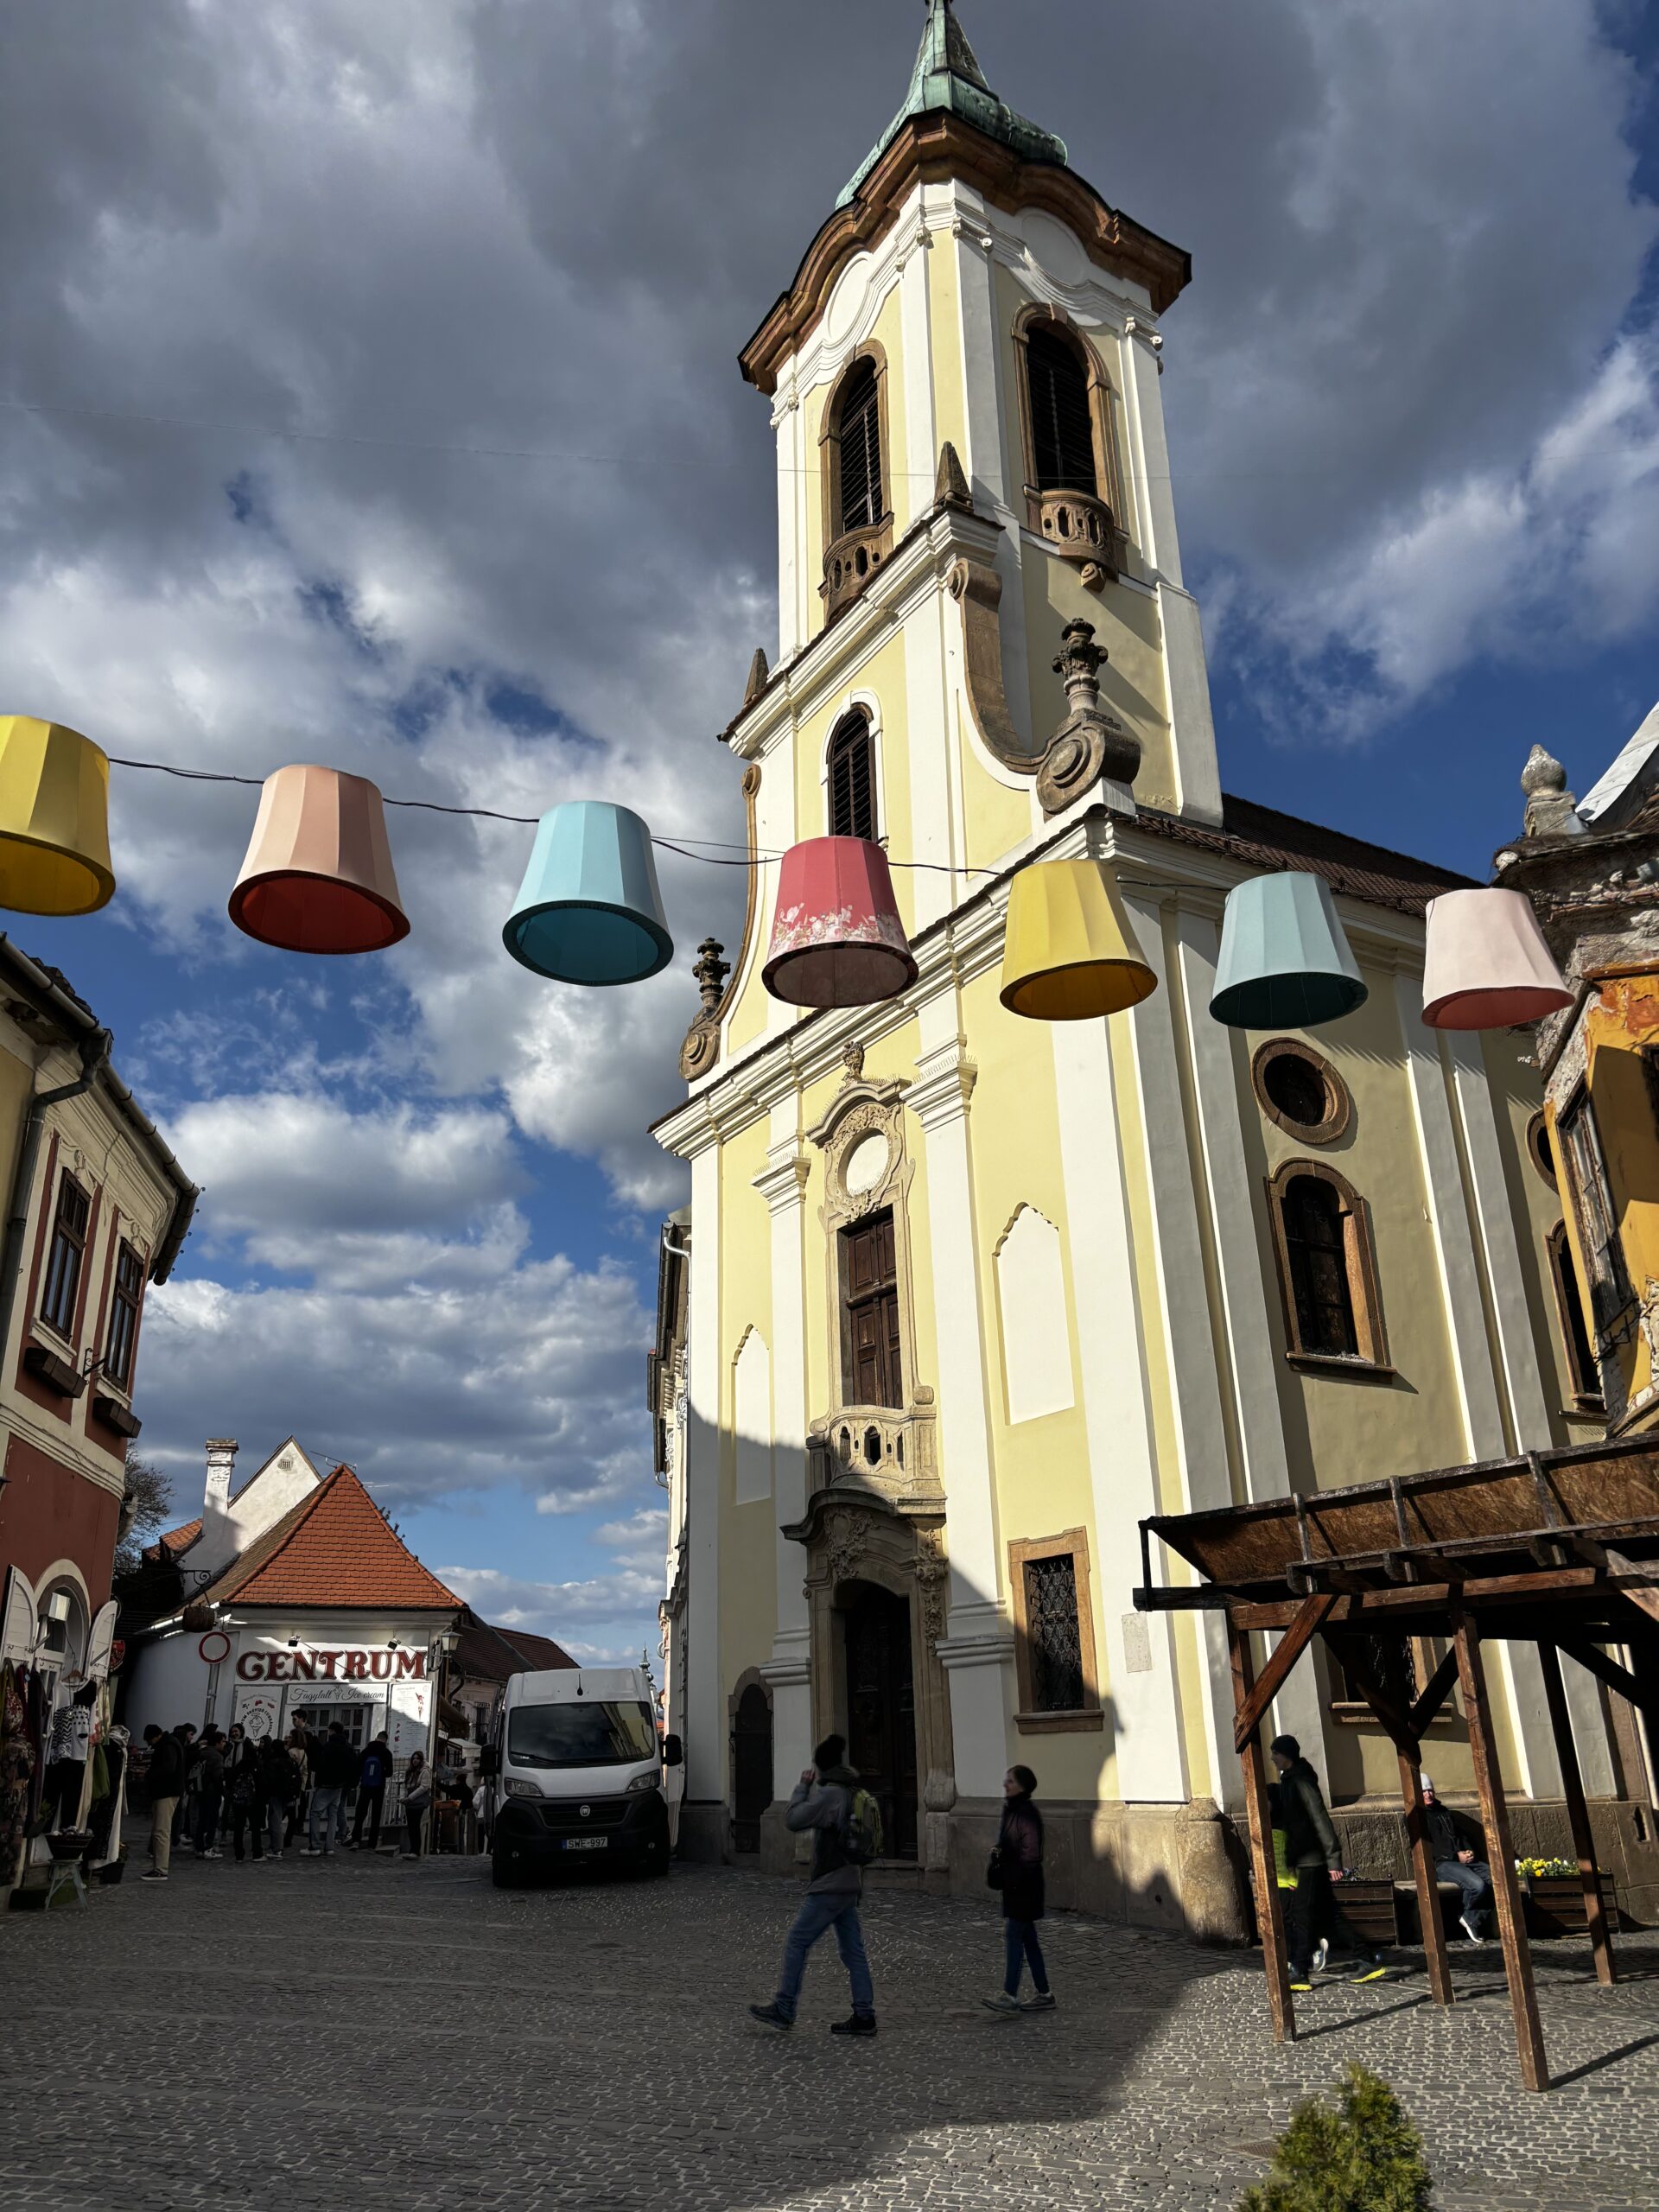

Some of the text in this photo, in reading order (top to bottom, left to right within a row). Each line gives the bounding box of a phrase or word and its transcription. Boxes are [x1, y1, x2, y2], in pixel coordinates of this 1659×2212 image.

[290, 1688, 332, 1702] Fagylalt
[341, 1688, 359, 1700] Ice
[568, 1838, 606, 1848] SWE-997
